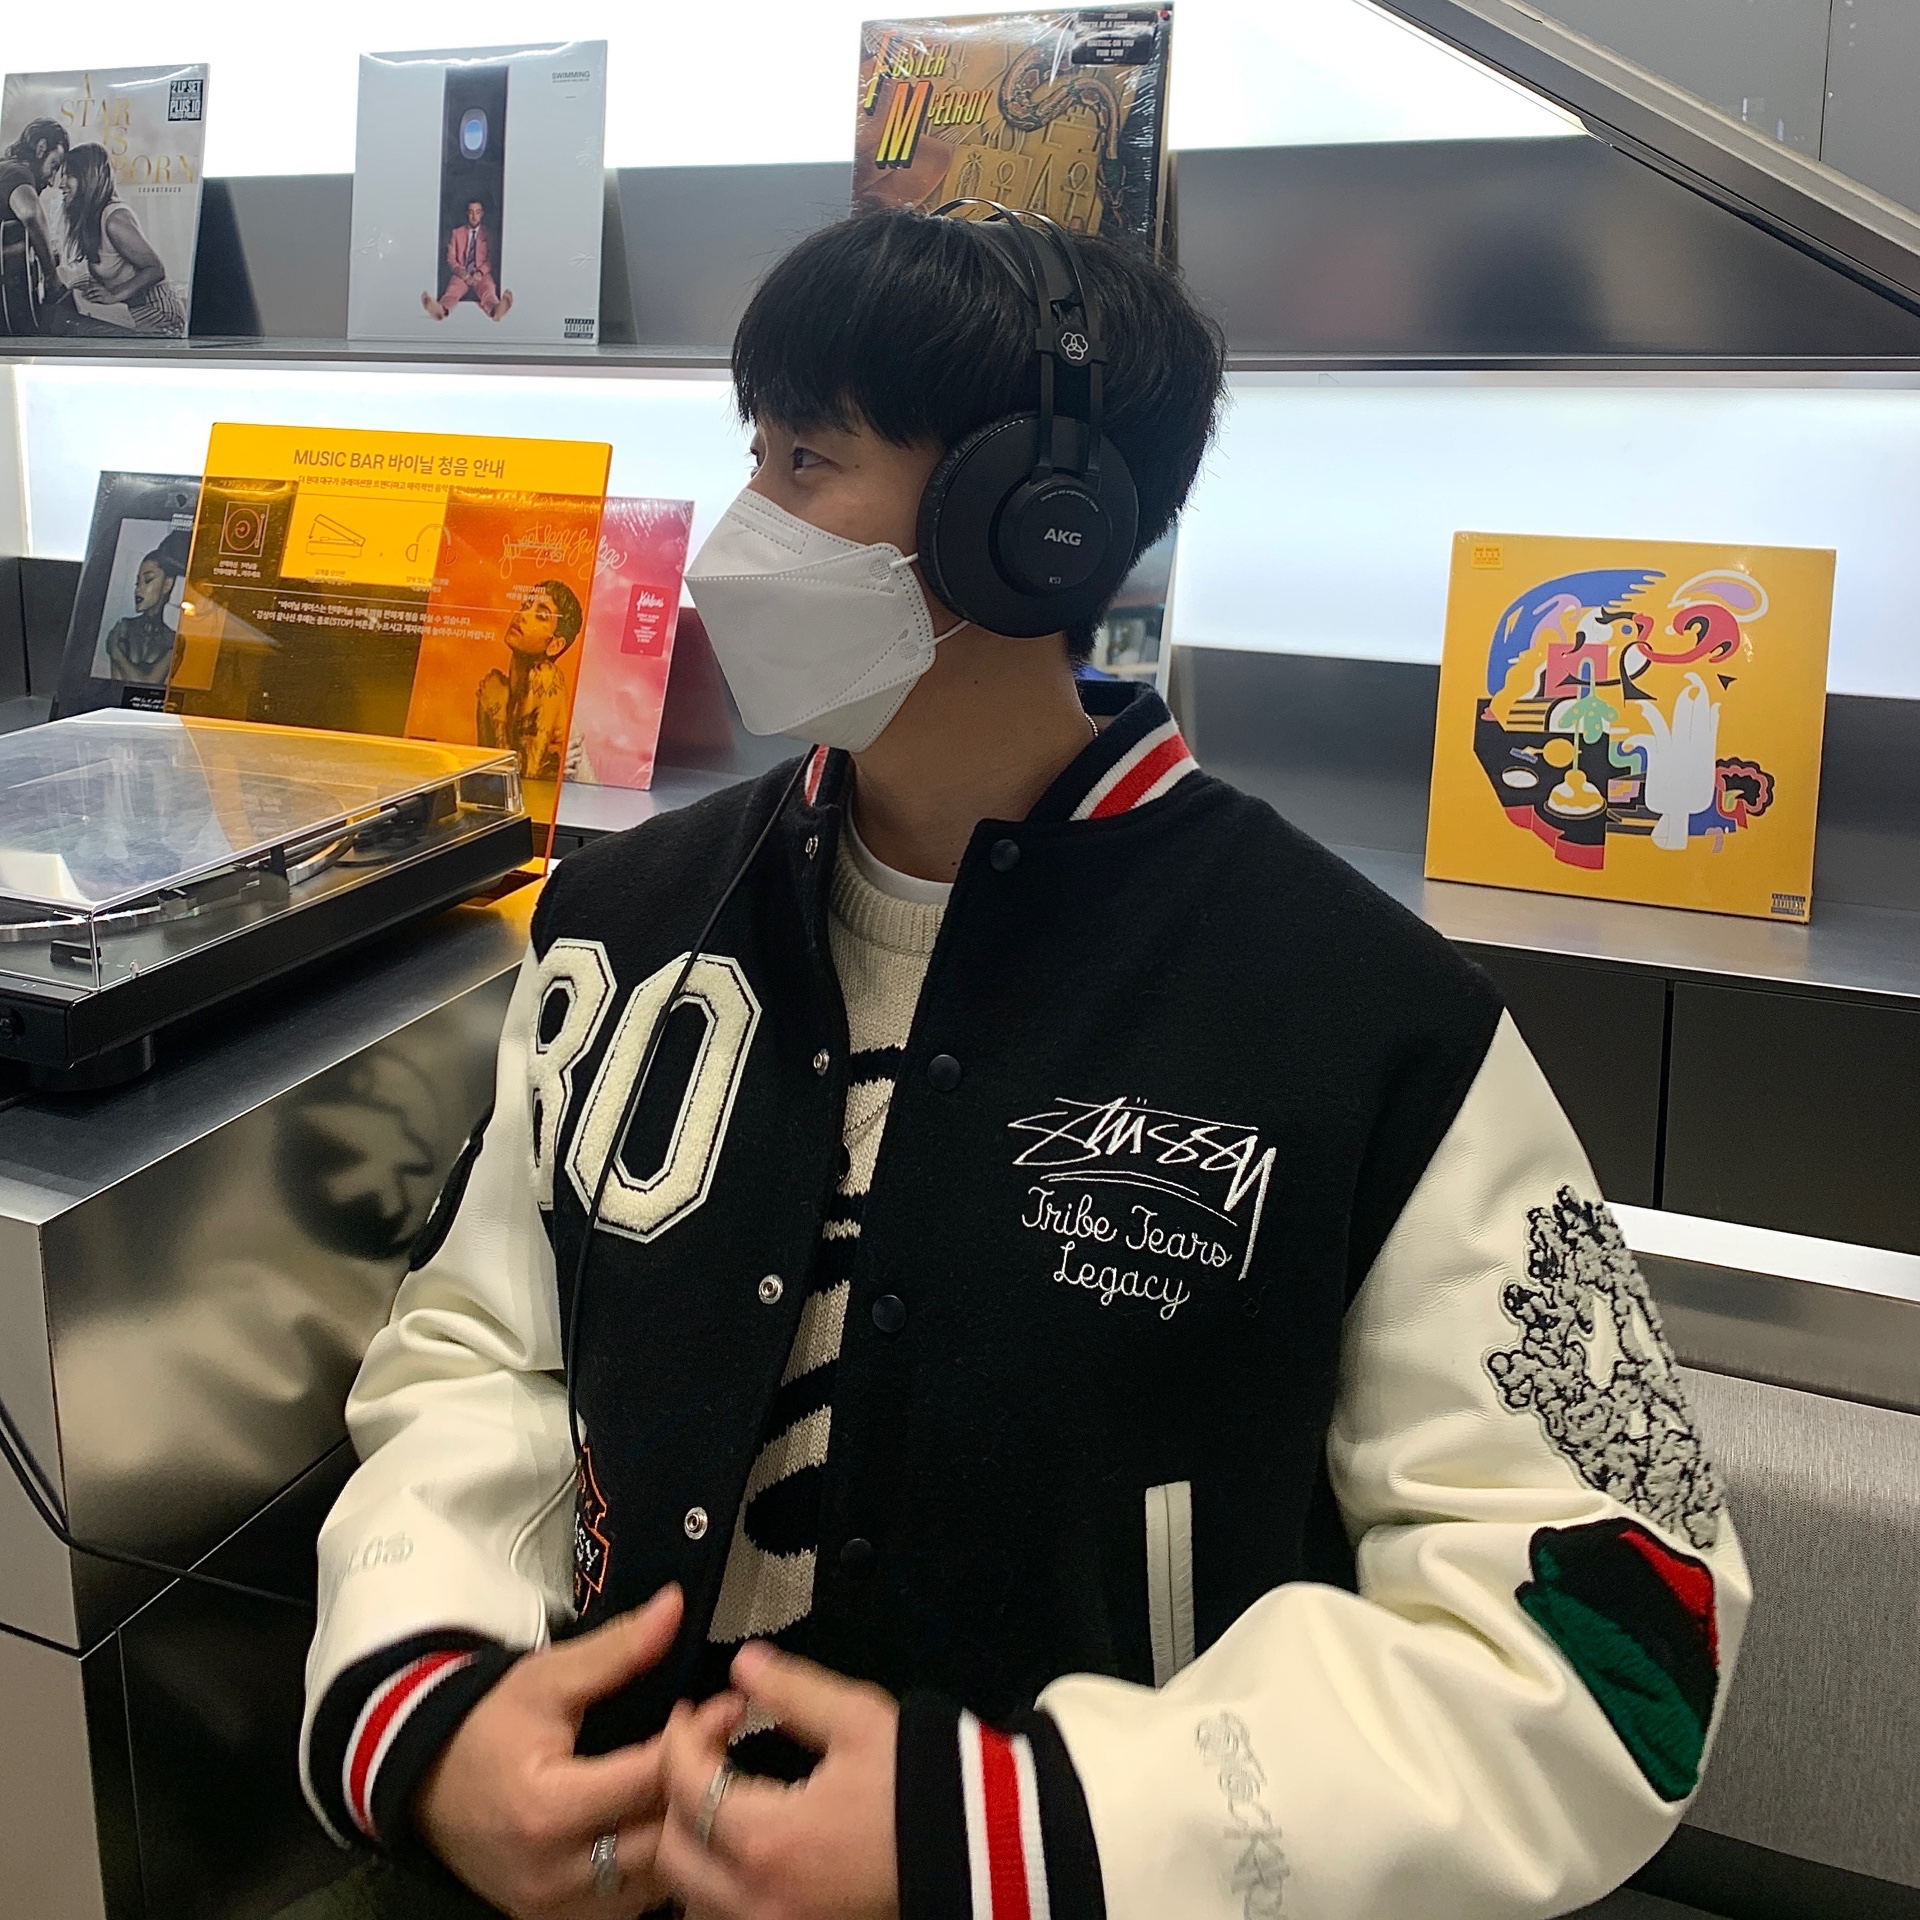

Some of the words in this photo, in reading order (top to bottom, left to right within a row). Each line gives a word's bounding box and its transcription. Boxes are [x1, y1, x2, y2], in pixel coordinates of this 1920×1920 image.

[83, 72, 93, 100] A
[171, 81, 178, 93] 2
[188, 81, 201, 92] SET
[551, 71, 591, 79] SWIMMING
[61, 97, 132, 127] STAR
[171, 100, 190, 112] PLUS
[111, 154, 198, 184] BORN
[293, 449, 347, 467] MUSIC
[350, 453, 385, 469] BAR
[388, 453, 434, 475] 바이닐
[437, 456, 468, 477] 청음
[473, 458, 505, 479] 안내
[1044, 528, 1082, 546] AKG
[529, 937, 763, 1244] 80
[1021, 1186, 1118, 1242] Tribe
[1126, 1205, 1233, 1268] Tears
[1053, 1241, 1190, 1320] Legacy
